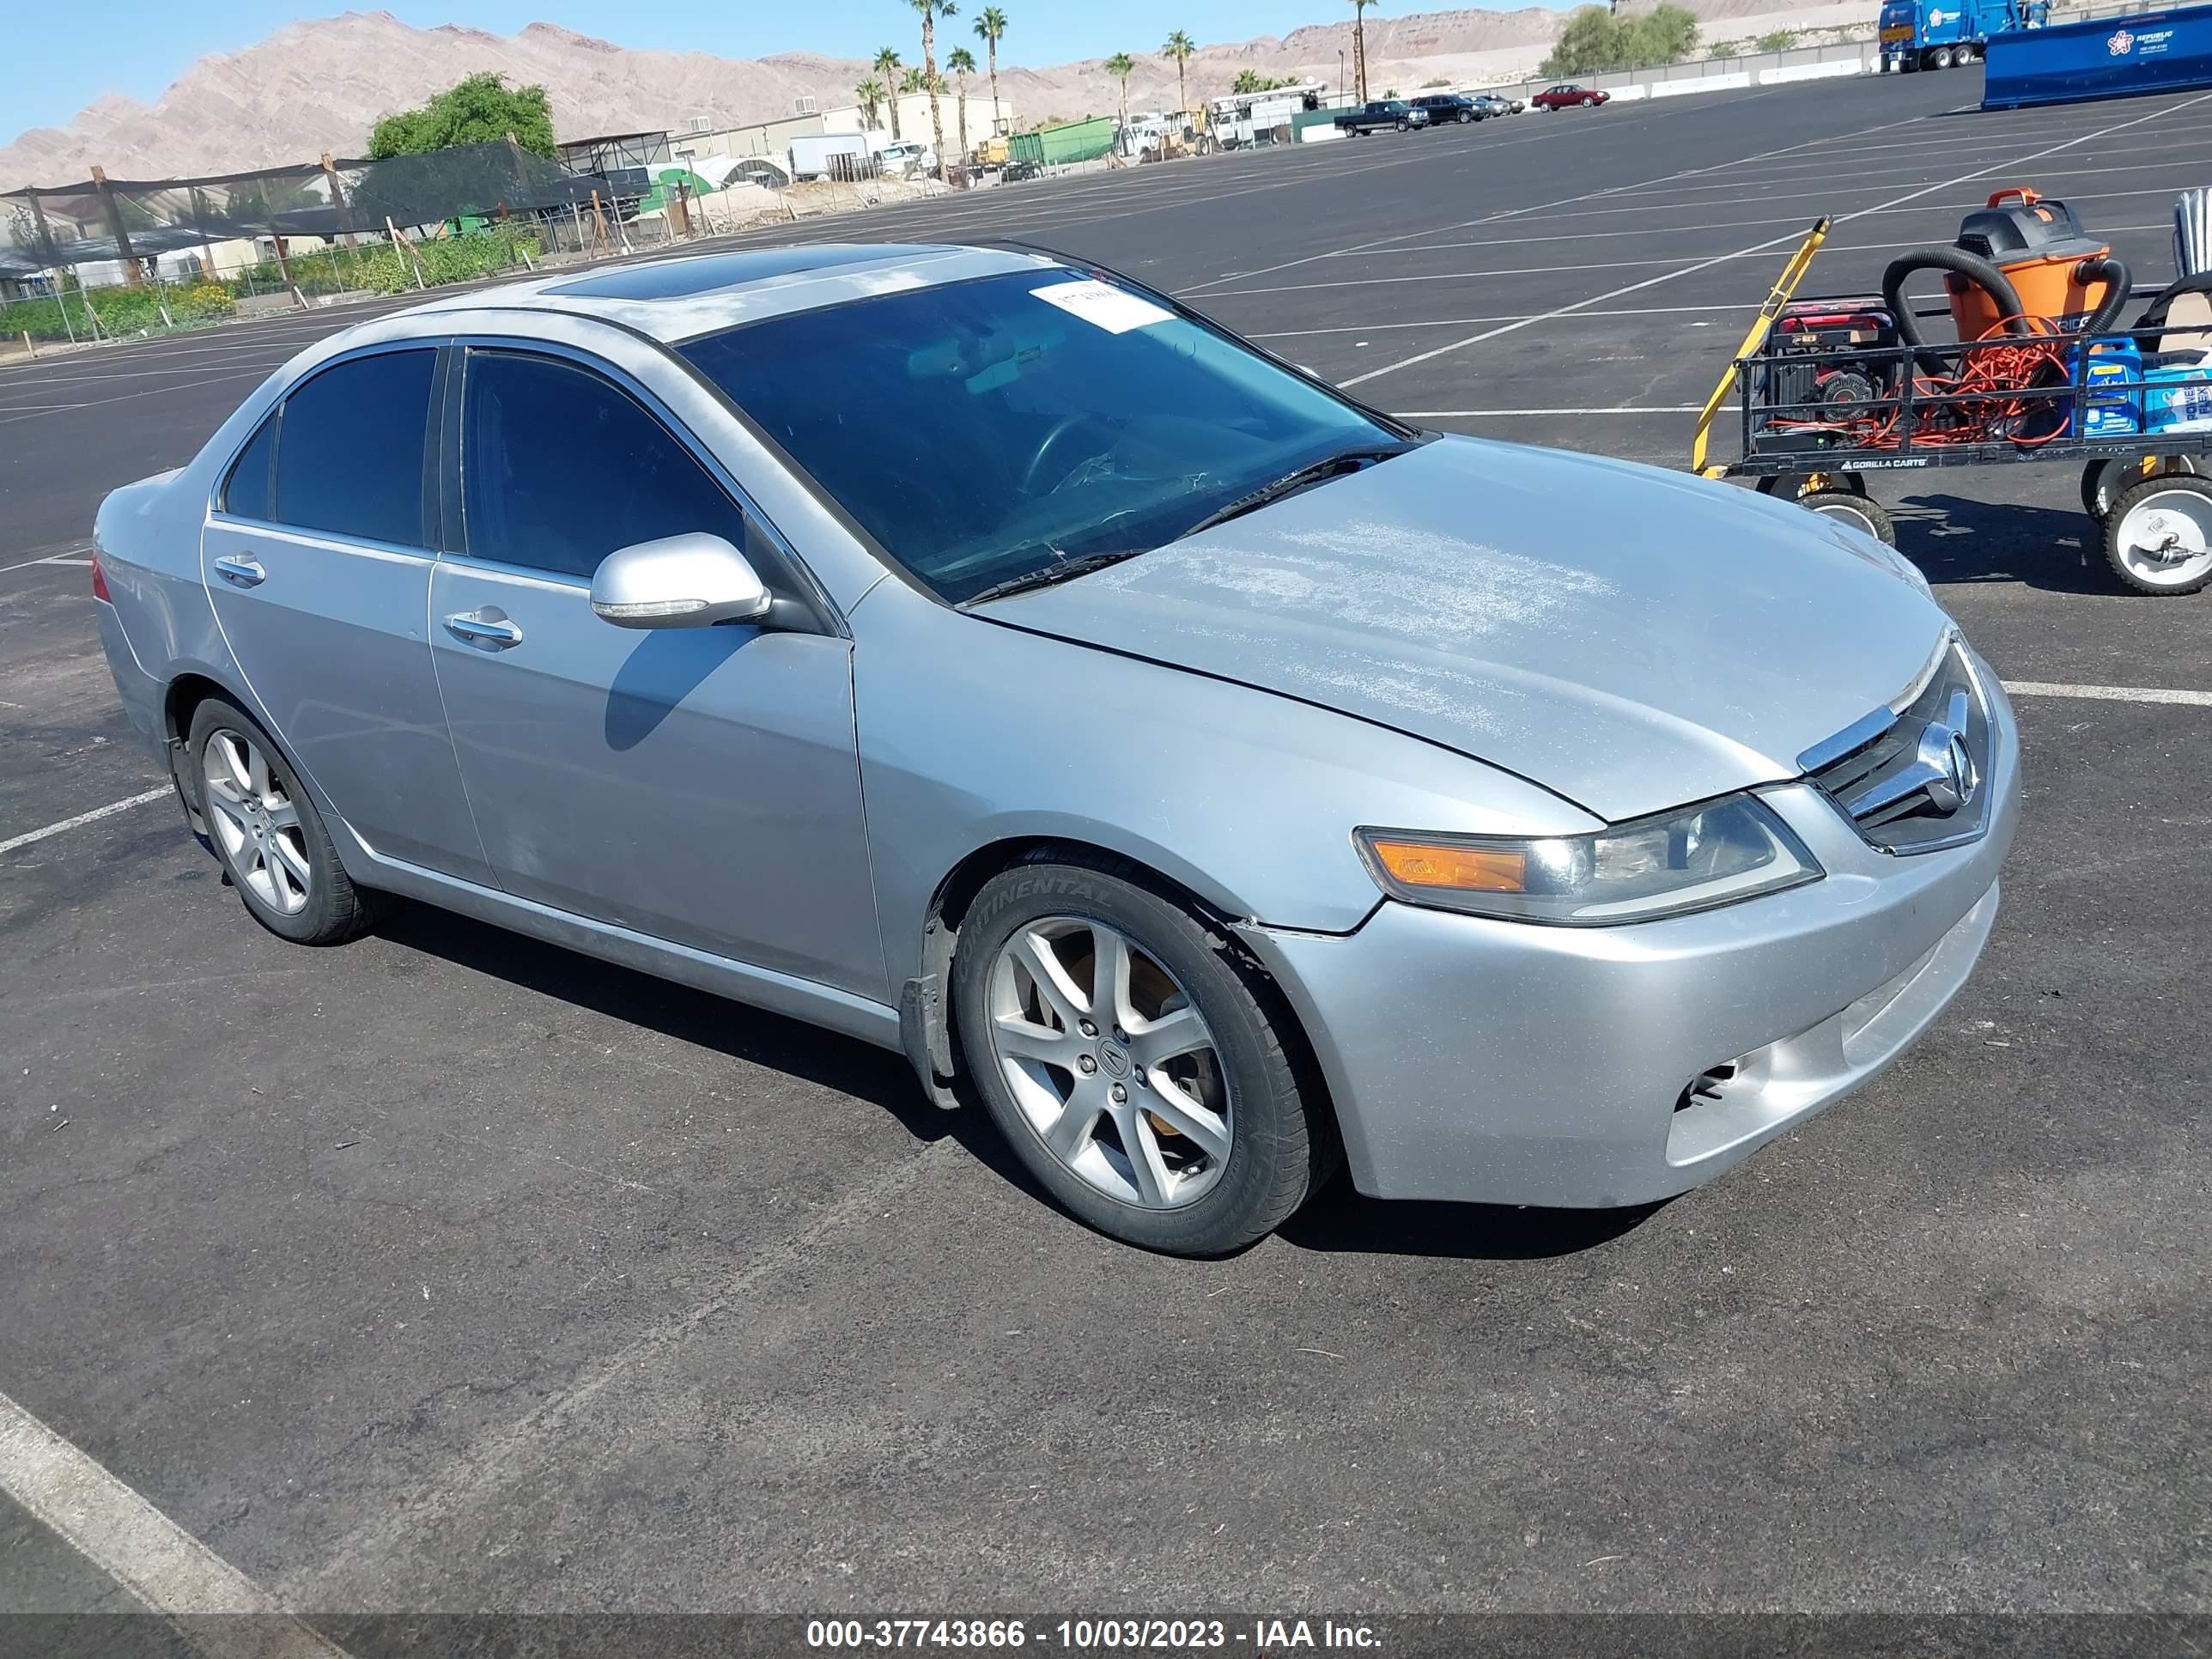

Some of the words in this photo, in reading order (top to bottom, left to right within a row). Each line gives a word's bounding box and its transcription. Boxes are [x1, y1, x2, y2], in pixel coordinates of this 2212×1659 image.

[1852, 460, 1892, 469] GORILLA
[1893, 459, 1927, 467] CARTS
[959, 878, 1112, 983] CONTINENTAL
